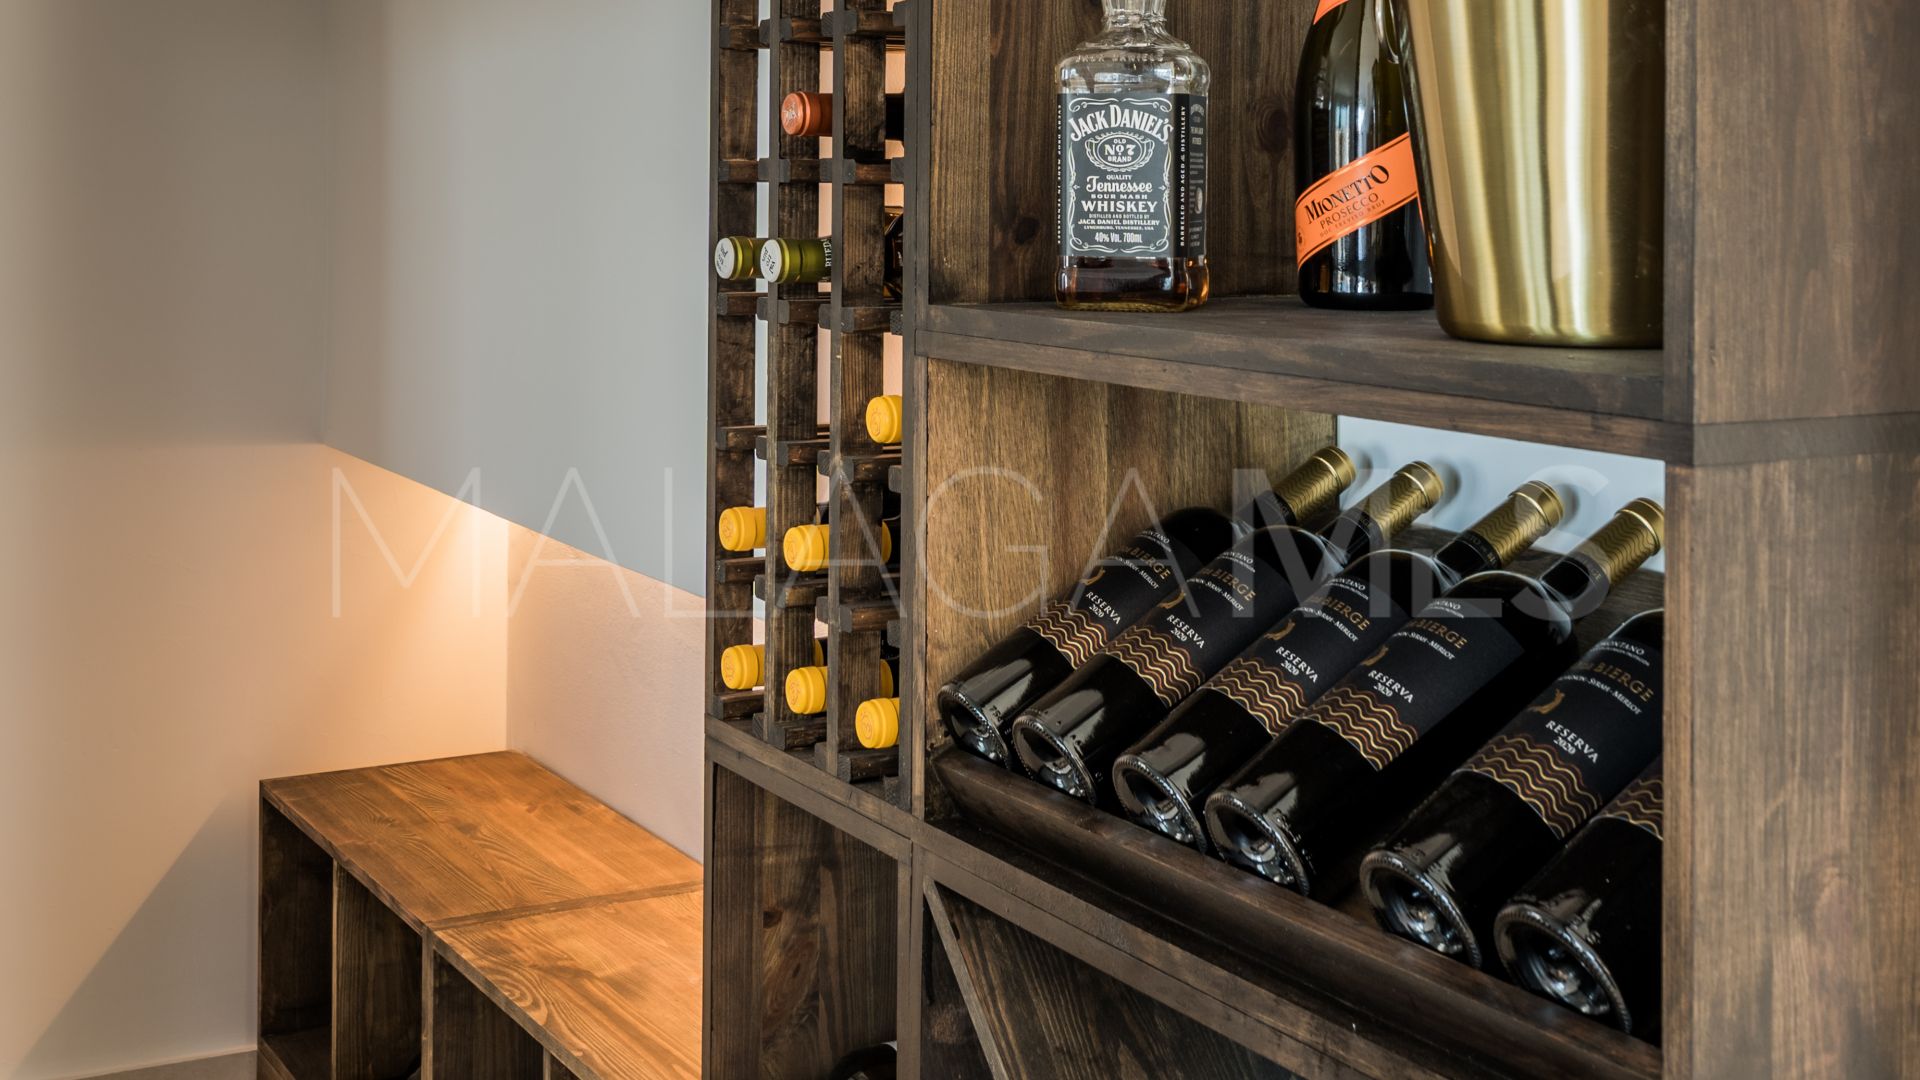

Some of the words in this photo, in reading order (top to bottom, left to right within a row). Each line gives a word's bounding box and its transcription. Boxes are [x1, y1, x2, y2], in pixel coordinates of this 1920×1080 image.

[1068, 110, 1109, 142] JACK
[1109, 104, 1174, 145] DANIEL'S
[1107, 155, 1132, 163] BRAND
[1085, 175, 1153, 193] Tennessee
[1304, 164, 1390, 225] MIONETTO
[1081, 200, 1158, 213] WHISKEY
[1319, 192, 1379, 230] PROSECCO
[1094, 232, 1110, 243] 40%
[1086, 591, 1121, 625] RESERVA
[1089, 604, 1105, 618] 2020
[1166, 614, 1205, 649] RESERVA
[1170, 627, 1188, 642] 2020
[1275, 646, 1319, 683] RESERVA
[1280, 660, 1300, 676] 2020
[1368, 669, 1414, 704] RESERVA
[1373, 682, 1394, 697] 2020
[1545, 720, 1599, 763] RESERVA
[1553, 736, 1577, 755] 2020
